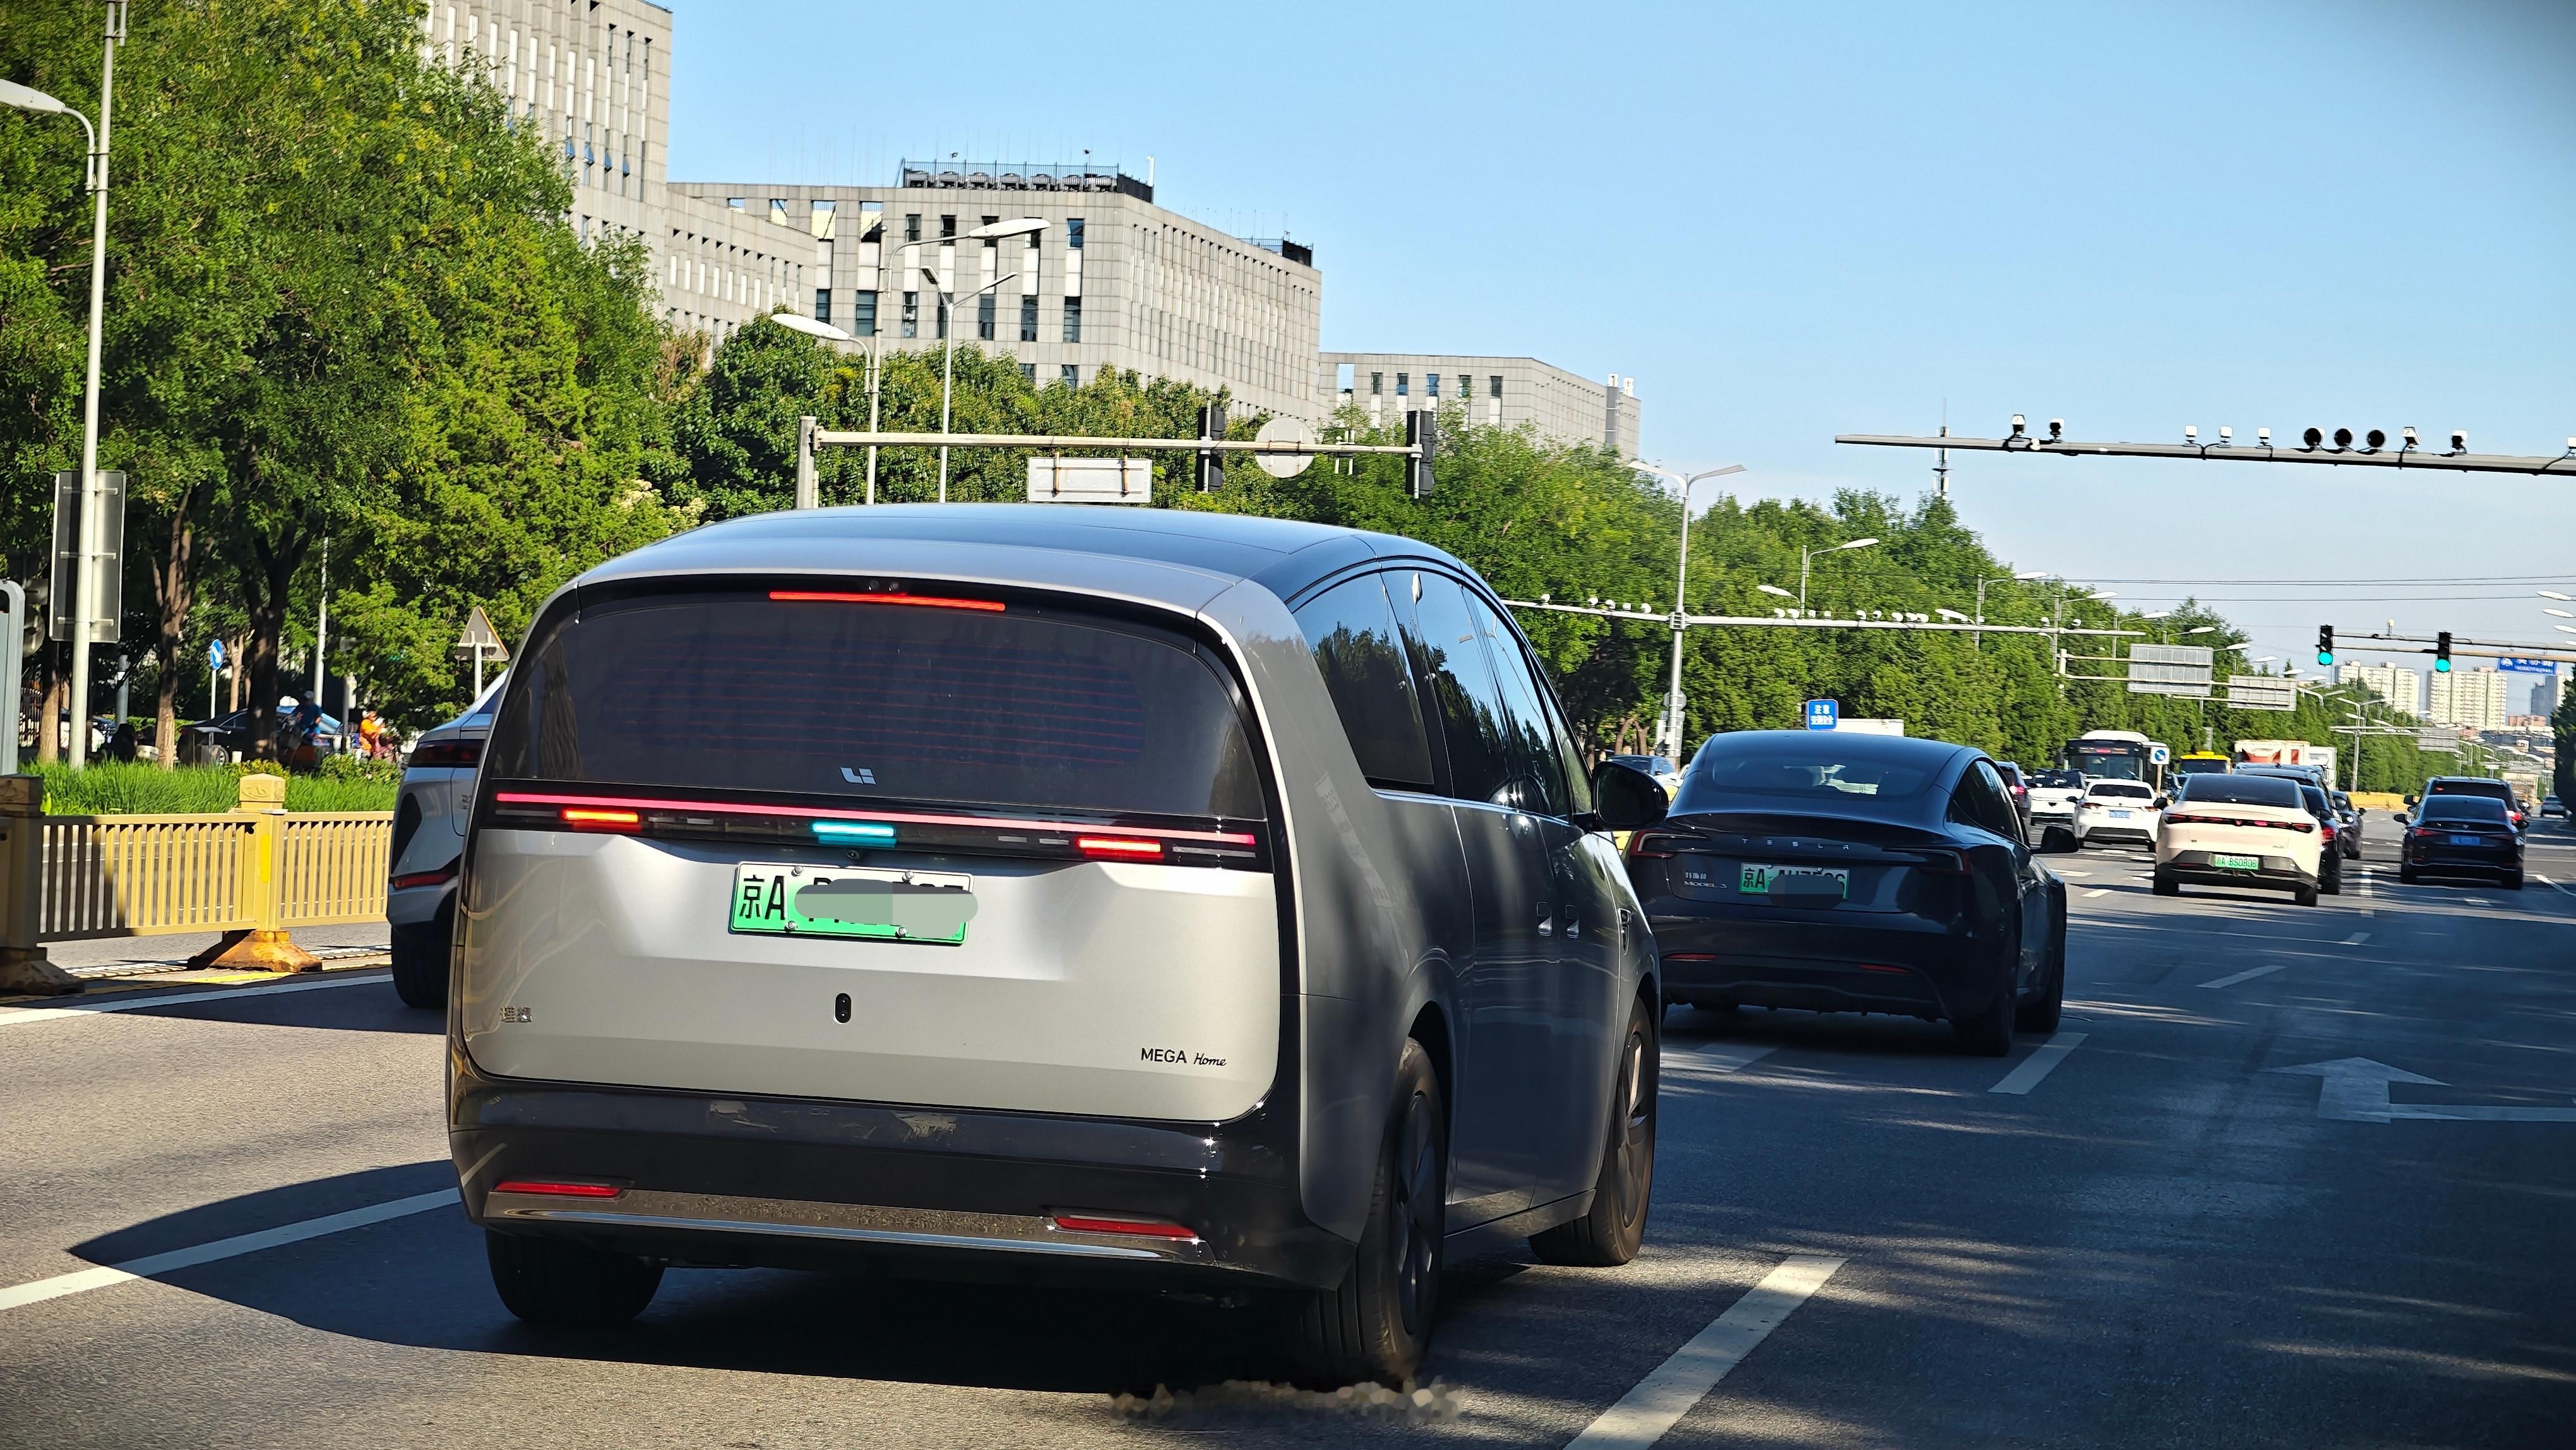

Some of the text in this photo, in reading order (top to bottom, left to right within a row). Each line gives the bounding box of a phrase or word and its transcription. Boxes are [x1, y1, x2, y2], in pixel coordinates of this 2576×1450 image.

[1742, 838, 1849, 850] TESLA
[1684, 880, 1718, 889] MODEL
[1743, 868, 1765, 889] 京A
[739, 875, 788, 921] 京A
[1141, 1047, 1227, 1067] MEGA Home
